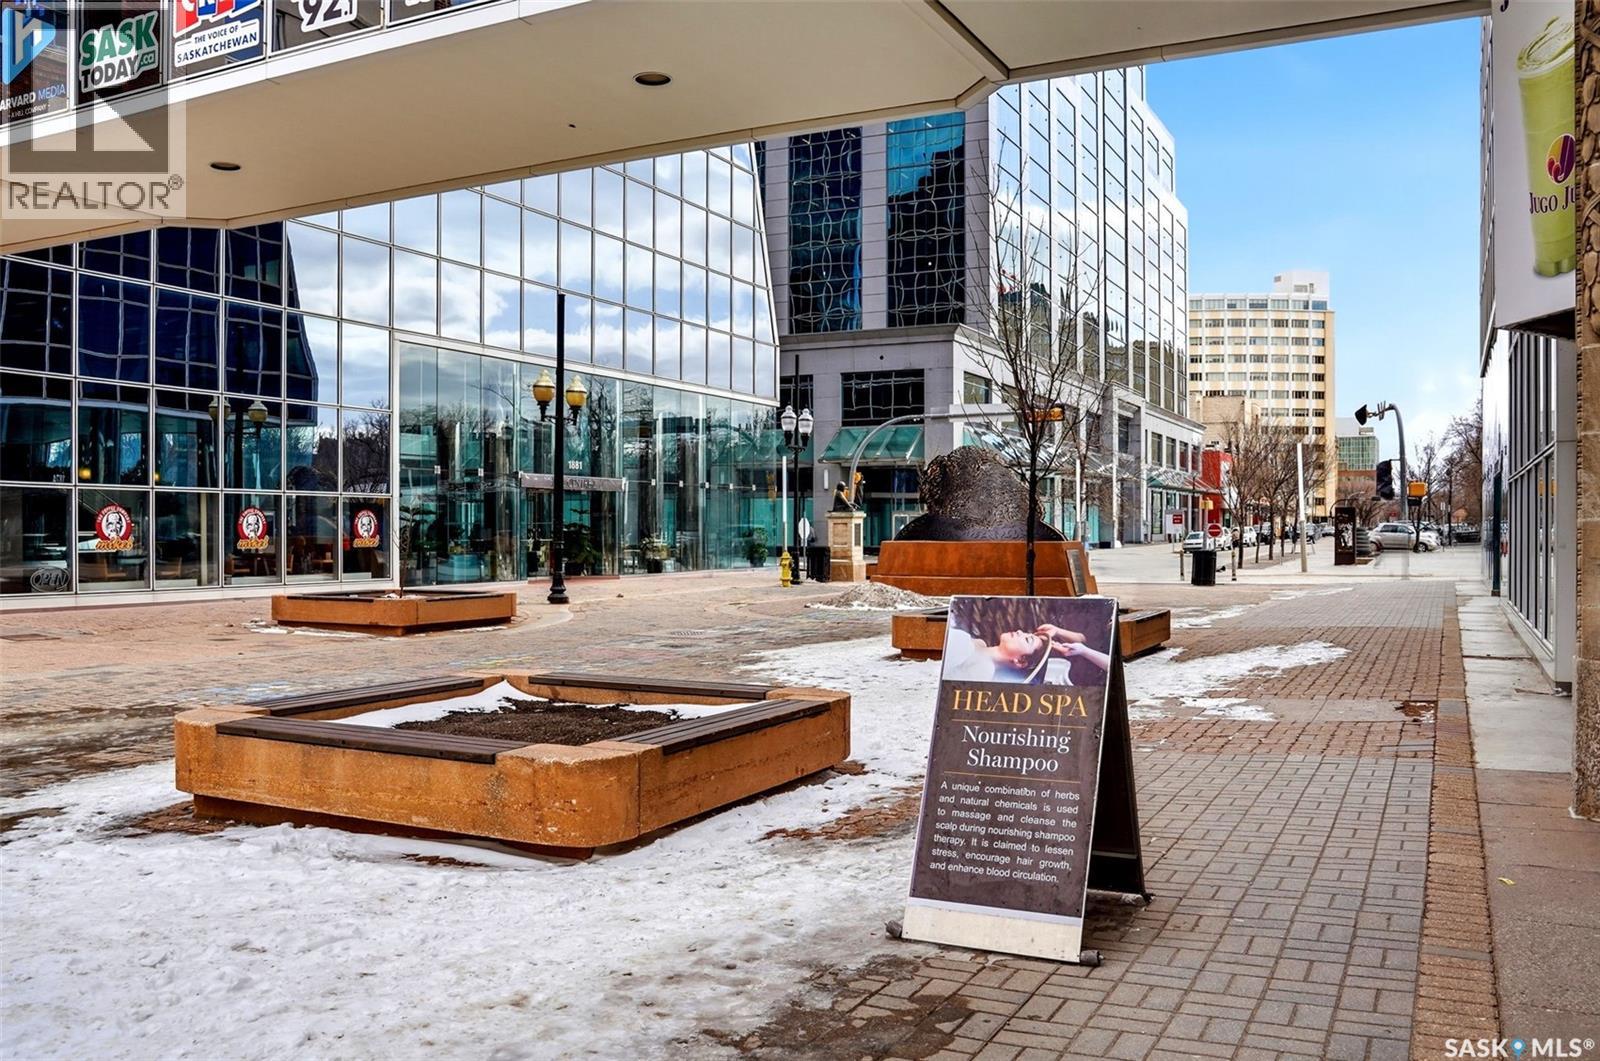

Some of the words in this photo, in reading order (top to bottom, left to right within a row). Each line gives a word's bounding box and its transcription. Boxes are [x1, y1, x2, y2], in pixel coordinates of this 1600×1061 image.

[81, 14, 155, 67] SASK
[194, 35, 206, 44] THE
[207, 29, 227, 40] VOICE
[229, 25, 239, 34] OF
[177, 31, 257, 64] SASKATCHEWAN
[81, 55, 138, 89] TODAY
[37, 83, 66, 101] MEDIA
[1529, 191, 1558, 214] JUGO
[568, 460, 583, 470] 1881
[951, 688, 1032, 714] HEAD
[1038, 693, 1088, 717] SPA
[961, 725, 1072, 753] Nourishing
[967, 748, 1059, 775] Shampoo
[941, 781, 947, 789] A
[952, 783, 979, 792] unique
[985, 785, 1036, 797] combination
[1041, 790, 1050, 798] of
[1055, 790, 1080, 800] herbs
[939, 795, 955, 803] and
[960, 797, 989, 806] natural
[995, 800, 1037, 811] chemicals
[1043, 804, 1050, 812] is
[1057, 806, 1078, 814] used
[938, 808, 945, 816] to
[952, 810, 991, 821] massage
[997, 814, 1014, 822] and
[1021, 816, 1055, 826] cleanse
[1063, 819, 1077, 828] the
[936, 822, 957, 832] scalp
[959, 824, 986, 835] during
[988, 827, 1032, 839] nourishing
[1034, 831, 1075, 842] shampoo
[934, 834, 966, 846] therapy.
[982, 839, 988, 847] is
[993, 840, 1026, 851] claimed
[1032, 844, 1040, 852] to
[1045, 845, 1073, 856] lessen
[932, 848, 959, 859] stress,
[965, 851, 1010, 864] encourage
[1017, 856, 1033, 866] hair
[1039, 859, 1071, 871] growth,
[930, 861, 945, 870] and
[948, 864, 984, 874] enhance
[986, 867, 1009, 877] blood
[1013, 870, 1058, 883] circulation.
